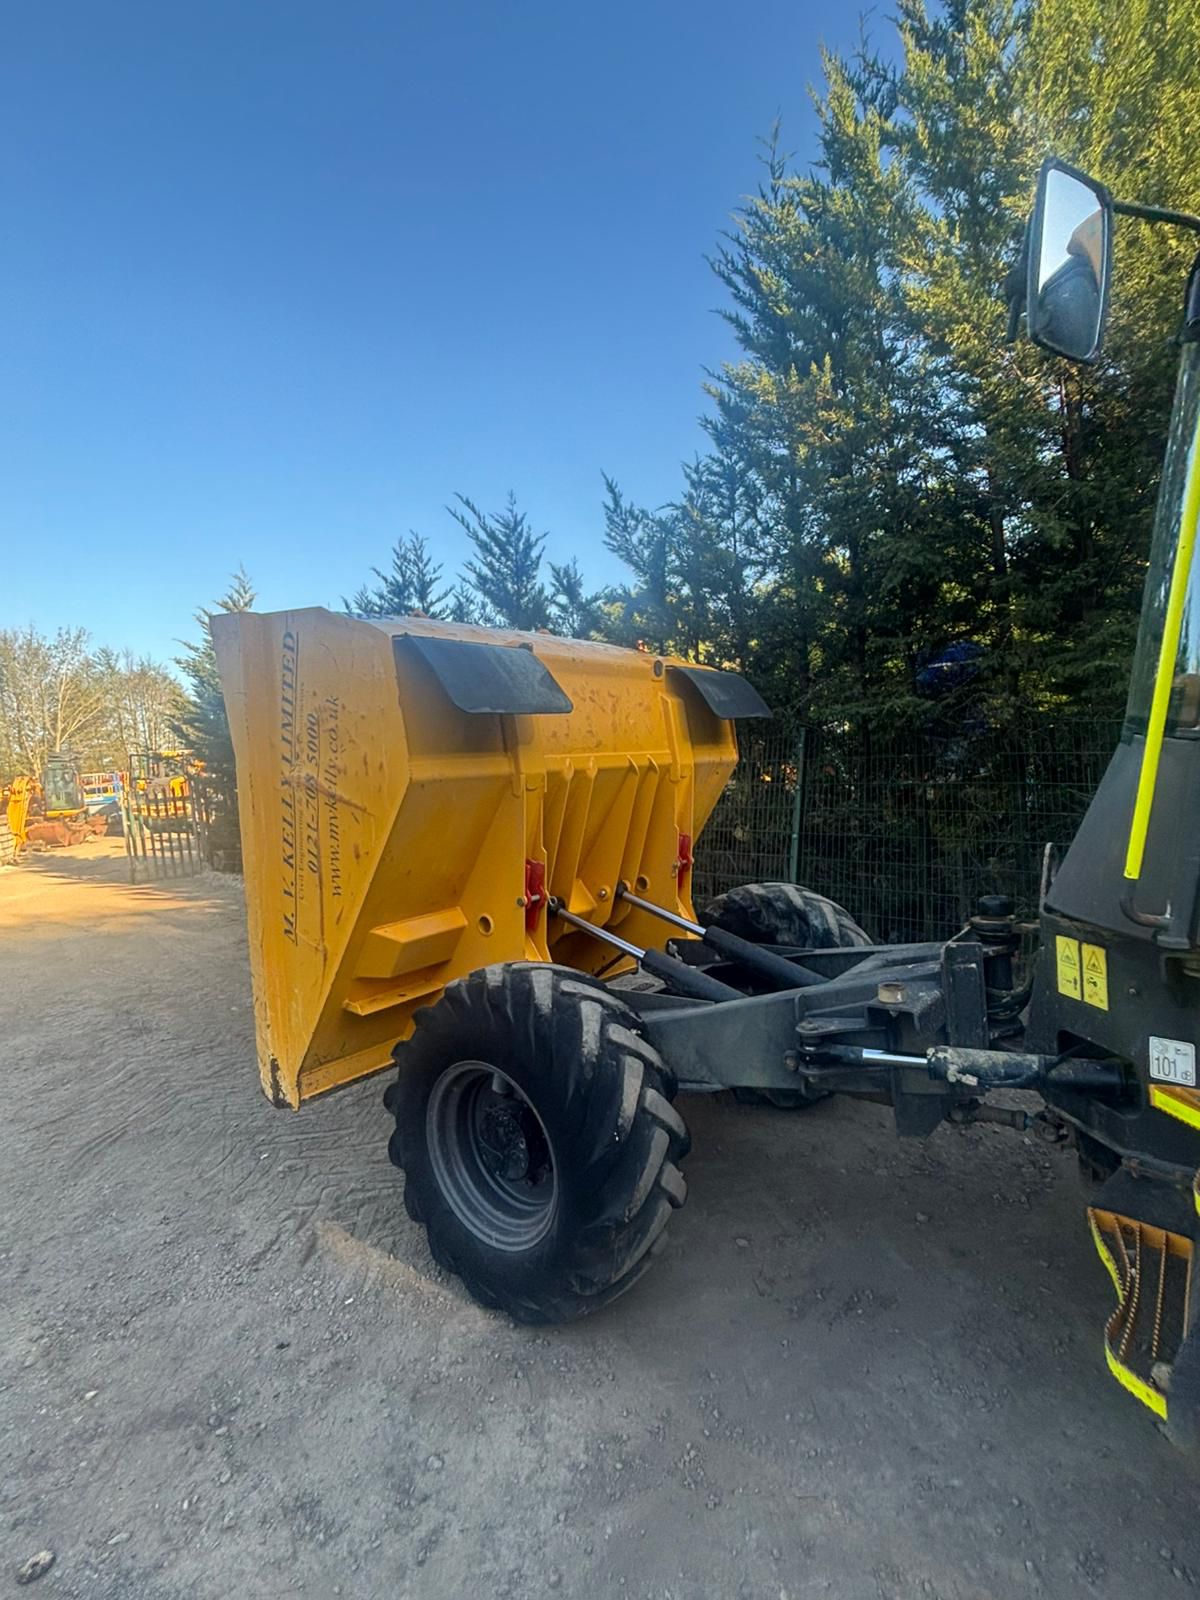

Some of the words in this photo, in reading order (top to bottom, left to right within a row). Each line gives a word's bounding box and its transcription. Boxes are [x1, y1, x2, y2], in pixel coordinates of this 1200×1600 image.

[281, 631, 296, 766] LIMITED
[306, 713, 319, 766] 5000
[281, 770, 295, 869] KELLY
[304, 773, 318, 873] 0121-708
[324, 695, 342, 897] www.mvkelly.co.uk
[282, 876, 295, 898] V.
[283, 911, 296, 943] M.
[1155, 1056, 1177, 1079] 101
